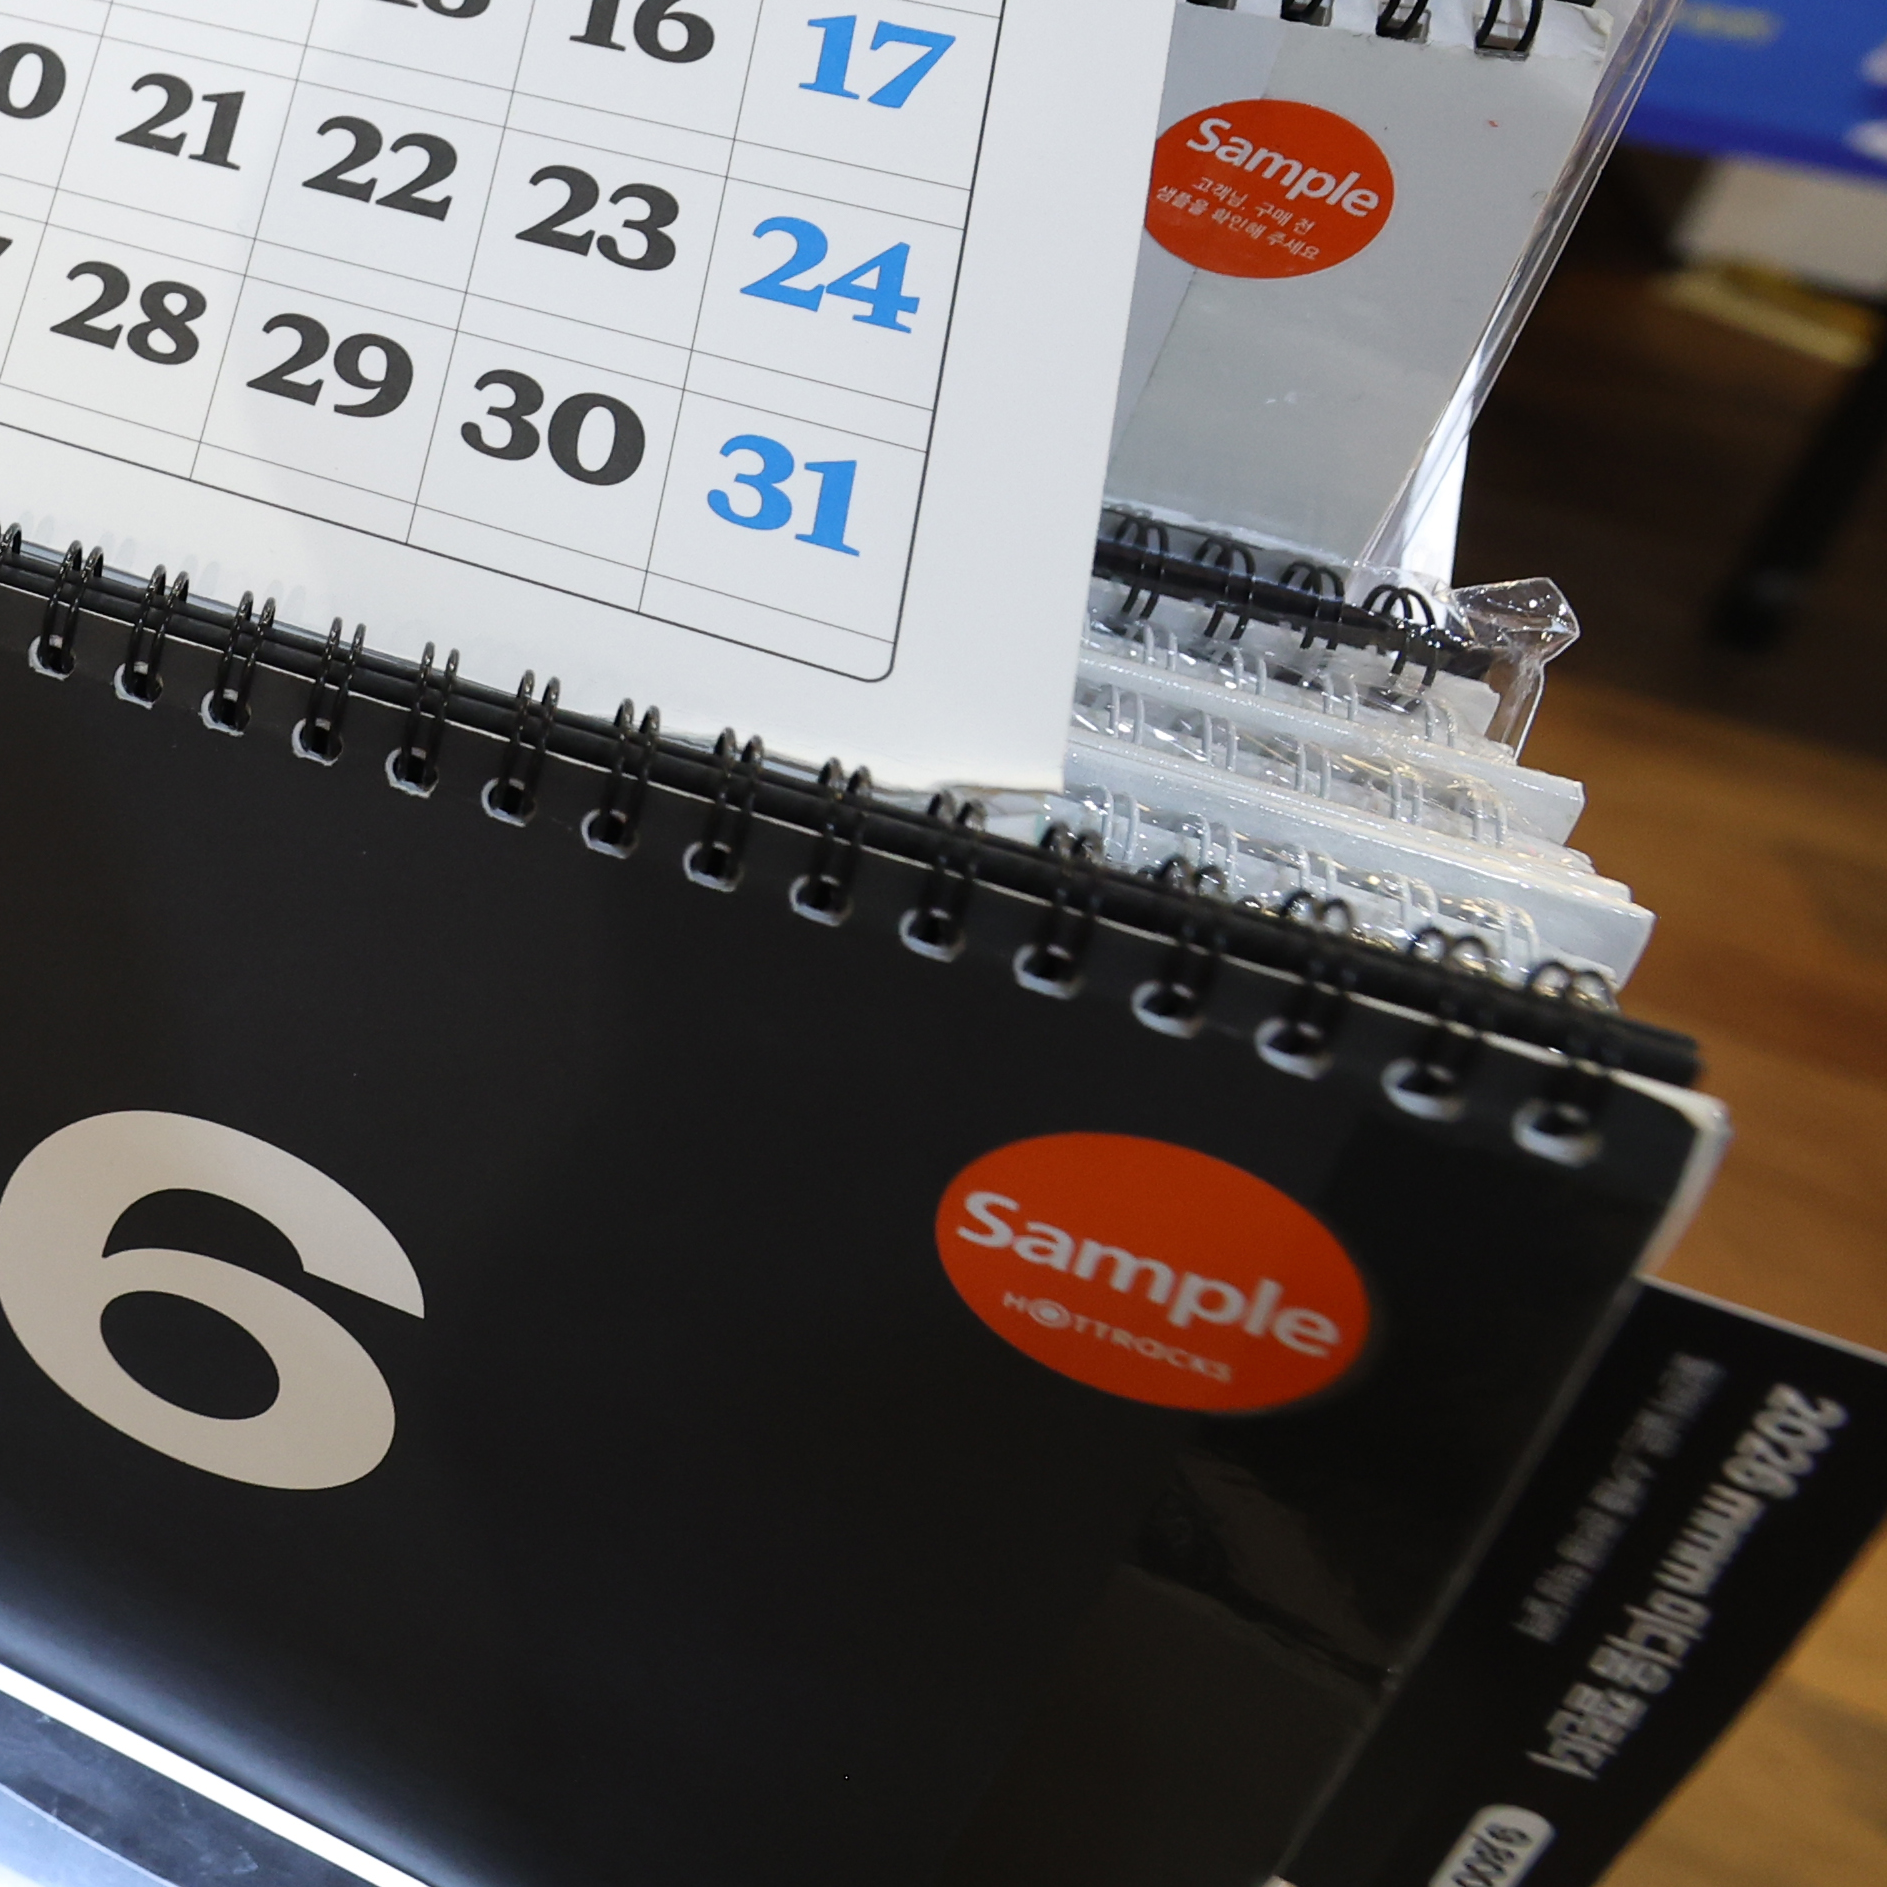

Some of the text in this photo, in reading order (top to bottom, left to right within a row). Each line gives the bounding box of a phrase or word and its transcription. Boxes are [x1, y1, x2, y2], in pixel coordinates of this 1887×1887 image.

[798, 14, 956, 109] 17
[115, 72, 246, 171] 21
[301, 115, 458, 222] 22
[514, 164, 680, 272] 23
[739, 216, 921, 334] 24
[1185, 117, 1379, 217] Sample
[1255, 203, 1293, 226] 구매
[1211, 207, 1267, 239] 확인해
[1267, 231, 1320, 261] 주세요
[49, 260, 208, 366] 28
[245, 312, 414, 419] 29
[460, 368, 646, 487] 30
[706, 433, 860, 557] 31
[955, 1190, 1342, 1359] Sample
[1719, 1381, 1849, 1501] 2026
[1653, 1482, 1767, 1597] mmm
[1525, 1682, 1649, 1782] 캘린더
